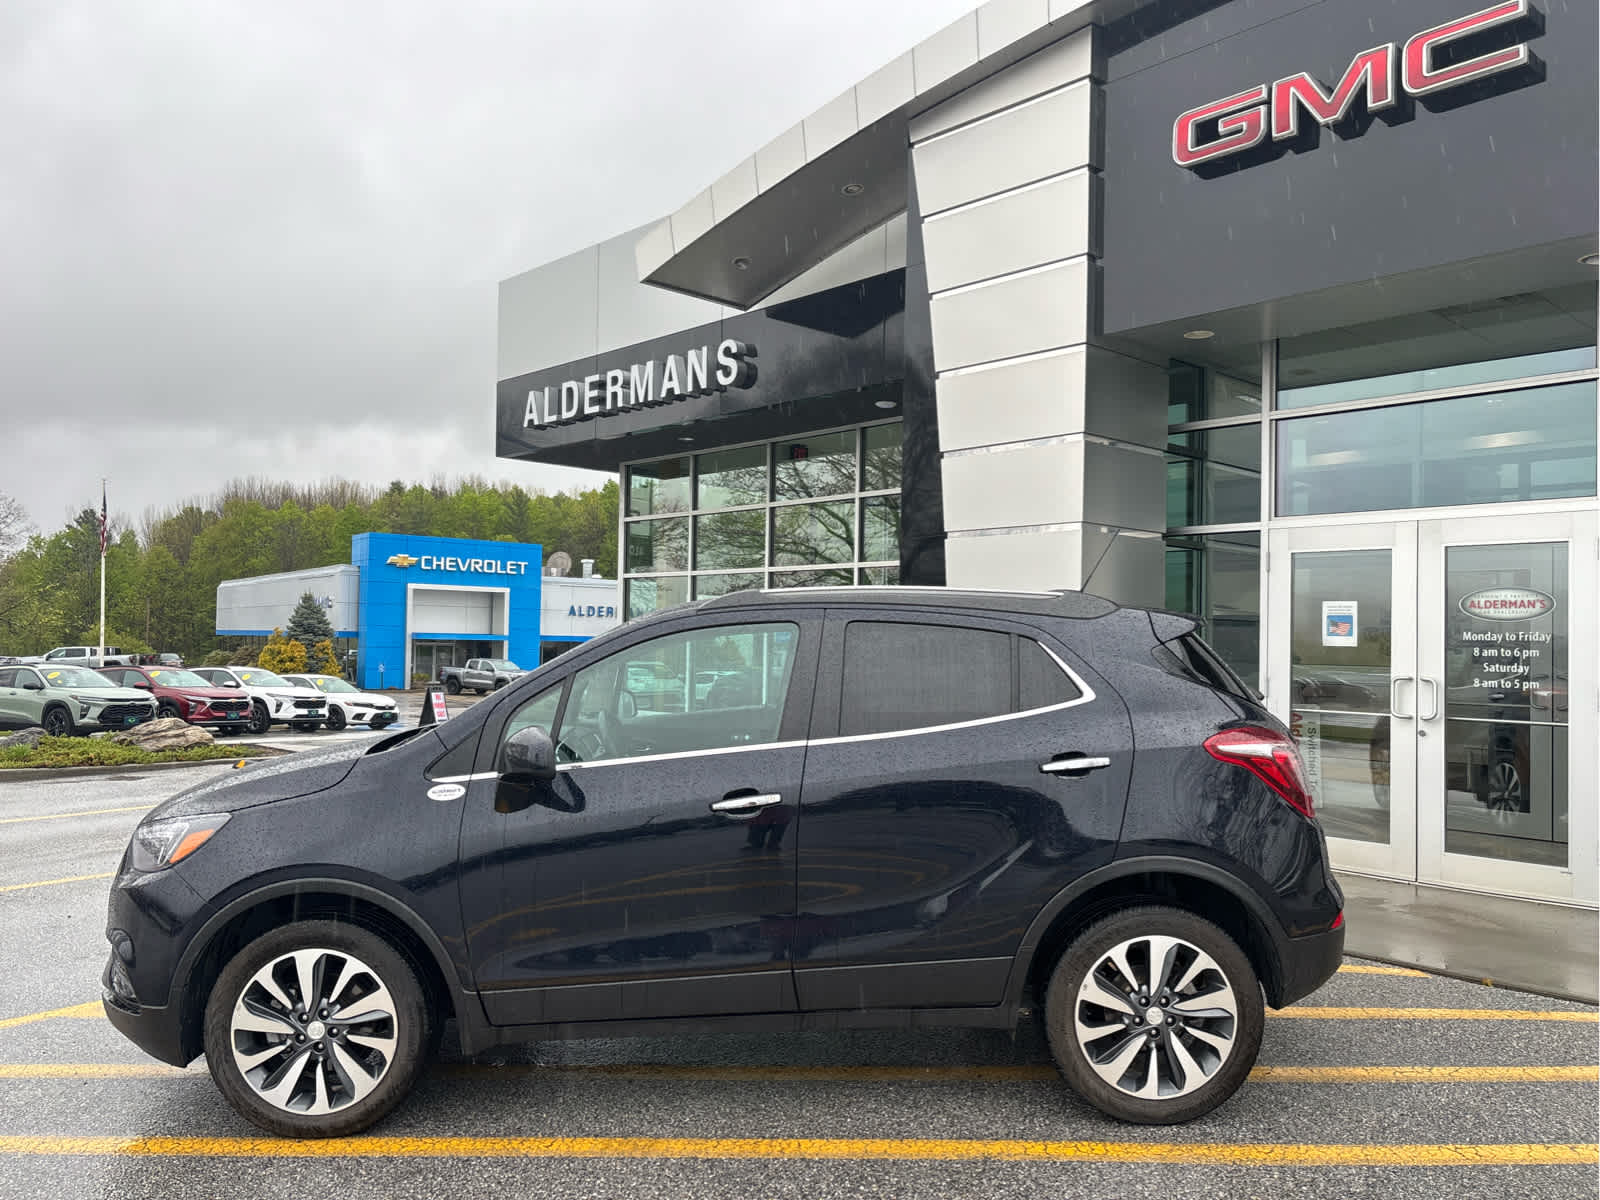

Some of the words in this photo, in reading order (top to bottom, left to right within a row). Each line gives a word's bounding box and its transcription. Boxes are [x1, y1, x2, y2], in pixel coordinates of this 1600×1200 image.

[1172, 0, 1529, 167] GMC
[523, 339, 744, 428] ALDERMANS
[421, 555, 529, 575] CHEVROLET
[568, 604, 618, 618] ALDER
[1468, 599, 1547, 610] ALDERMAN'S
[1462, 631, 1504, 644] Monday
[1505, 632, 1517, 641] to
[1518, 631, 1553, 644] Friday
[1473, 647, 1480, 657] 8
[1481, 649, 1498, 657] am
[1500, 648, 1512, 657] to
[1513, 647, 1521, 657] 6
[1522, 649, 1540, 659] pm
[1483, 662, 1531, 675] Saturday
[1473, 678, 1480, 688] 8
[1481, 680, 1498, 689] am
[1500, 680, 1512, 689] to
[1513, 679, 1521, 689] 5
[1522, 681, 1540, 692] pm
